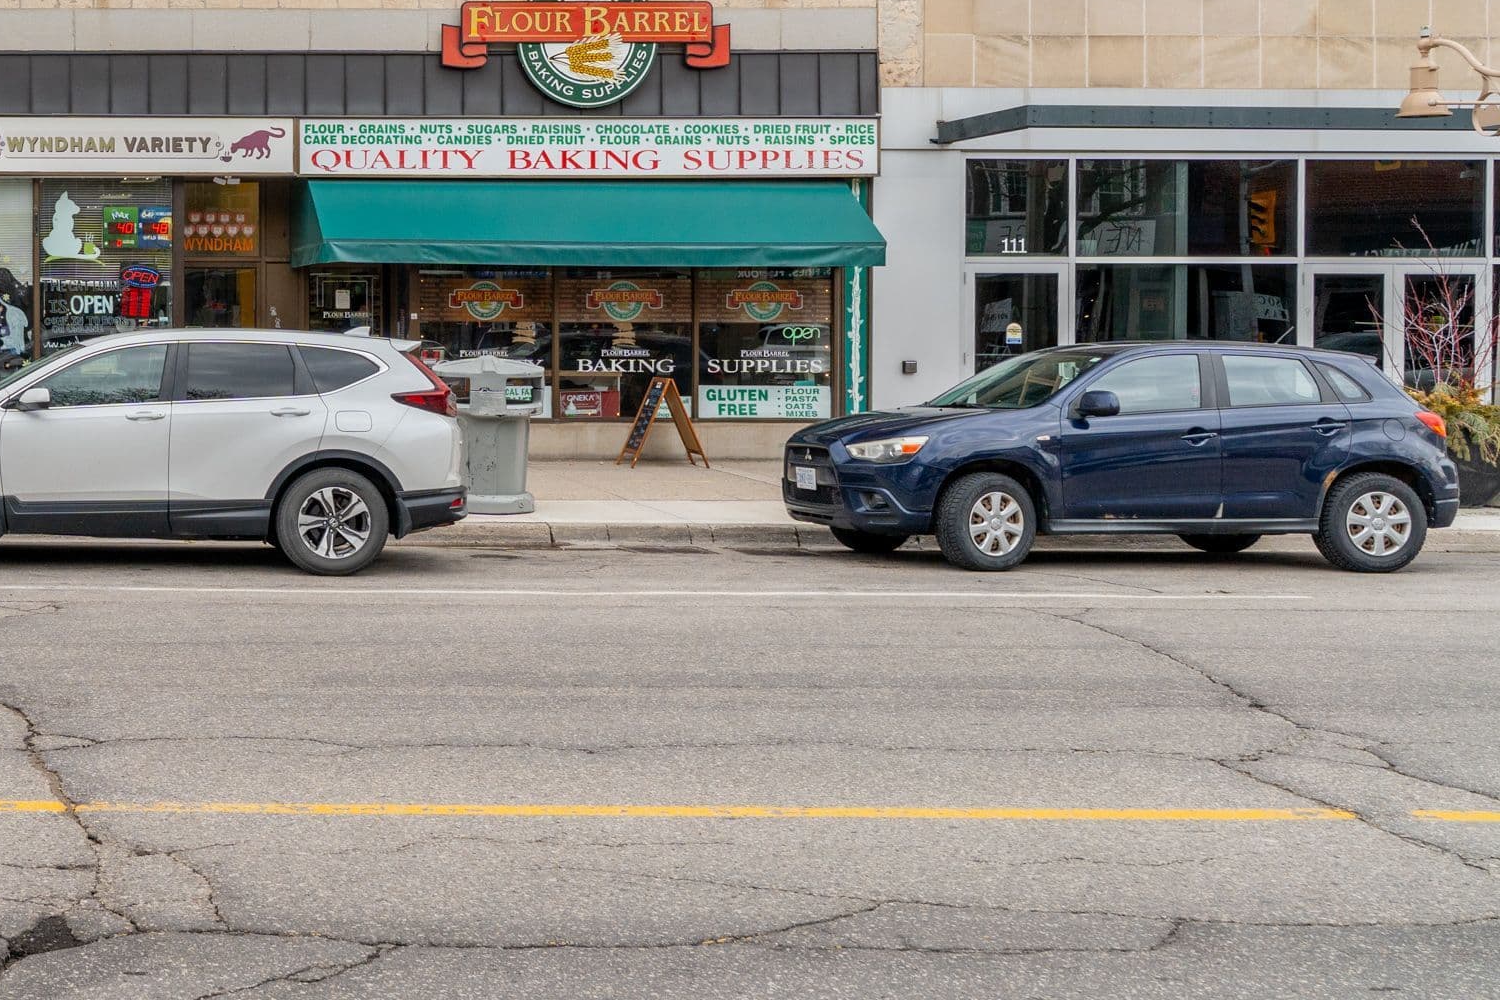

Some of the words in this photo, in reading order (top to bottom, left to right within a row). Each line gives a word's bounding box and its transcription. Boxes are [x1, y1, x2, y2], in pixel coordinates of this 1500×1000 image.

[468, 6, 573, 38] FLOUR
[583, 6, 709, 38] BARREL
[528, 51, 575, 96] BAKING
[582, 50, 647, 99] SUPPLIES
[304, 124, 345, 134] FLOUR
[358, 124, 406, 134] GRAINS
[420, 124, 453, 134] NUTS
[467, 124, 518, 134] SUGARS
[531, 124, 582, 134] RAISINS
[595, 124, 670, 134] CHOCOLATE
[683, 124, 740, 134] COOKIES
[753, 124, 791, 134] DRIED
[795, 124, 831, 134] FRUIT
[845, 124, 875, 134] RICE
[6, 136, 116, 153] WYNDHAM
[123, 136, 212, 153] VARIETY
[303, 135, 337, 145] CAKE
[341, 135, 422, 145] DECORATING
[436, 135, 492, 145] CANDIES
[506, 135, 545, 145] DRIED
[549, 135, 585, 145] FRUIT
[599, 135, 641, 145] FLOUR
[654, 135, 702, 145] GRAINS
[716, 135, 750, 145] NUTS
[764, 135, 815, 145] RAISINS
[829, 135, 875, 145] SPICES
[311, 149, 485, 172] QUALITY
[506, 149, 662, 171] BAKING
[683, 149, 865, 171] SUPPLIES
[116, 222, 134, 234] 40
[183, 237, 254, 251] WYNDHAM
[1001, 238, 1028, 254] 111
[123, 270, 159, 284] OPEN
[735, 291, 761, 302] FLOUR
[70, 295, 114, 314] OPEN
[782, 327, 821, 347] open
[576, 359, 677, 373] BAKING
[707, 359, 823, 374] SUPPLIES
[706, 389, 769, 402] GLUTEN
[785, 395, 819, 403] PASTA
[718, 403, 758, 416] FREE
